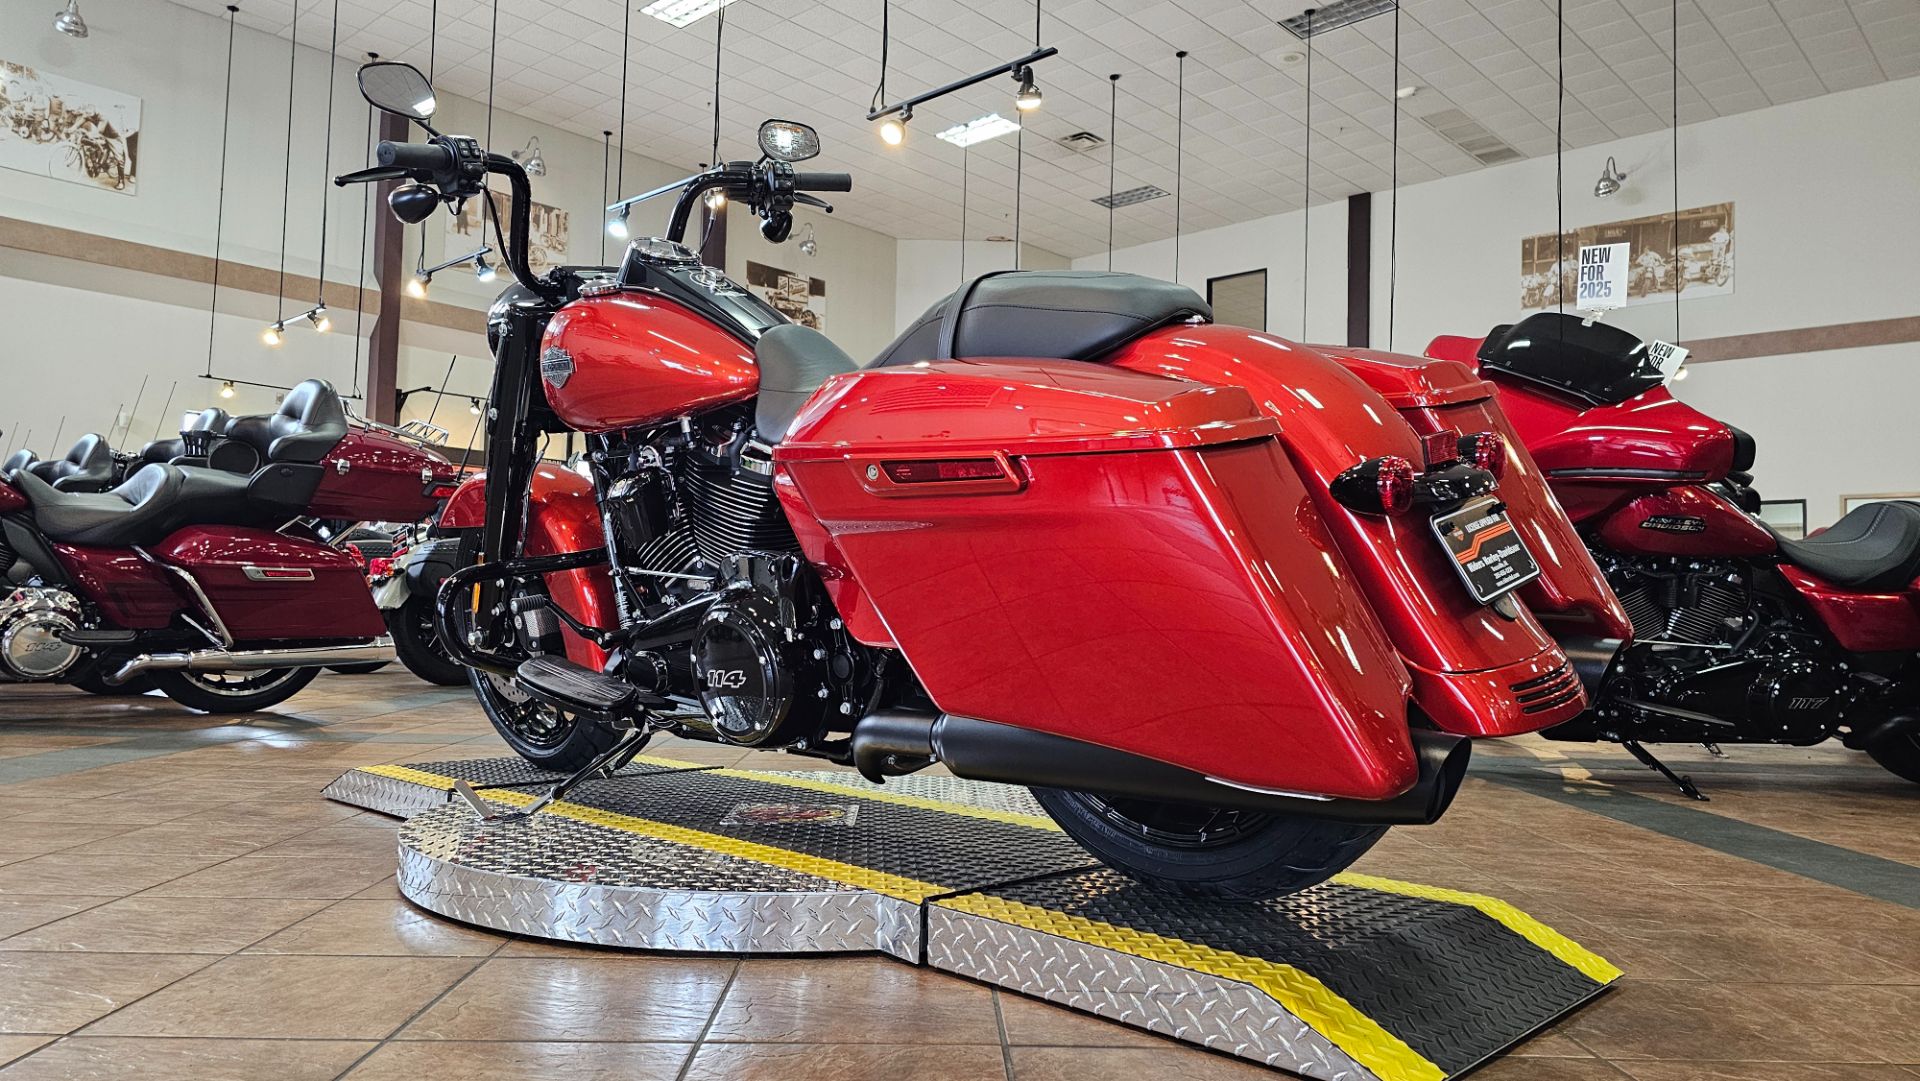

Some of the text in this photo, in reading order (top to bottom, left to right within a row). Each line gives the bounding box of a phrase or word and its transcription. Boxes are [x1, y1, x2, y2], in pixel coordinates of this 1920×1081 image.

[1582, 247, 1611, 264] NEW
[1580, 265, 1604, 282] FOR
[1579, 281, 1612, 299] 2025
[1651, 342, 1676, 359] NEW
[1650, 354, 1664, 369] OR
[707, 669, 747, 688] 114
[1789, 697, 1829, 709] 117
